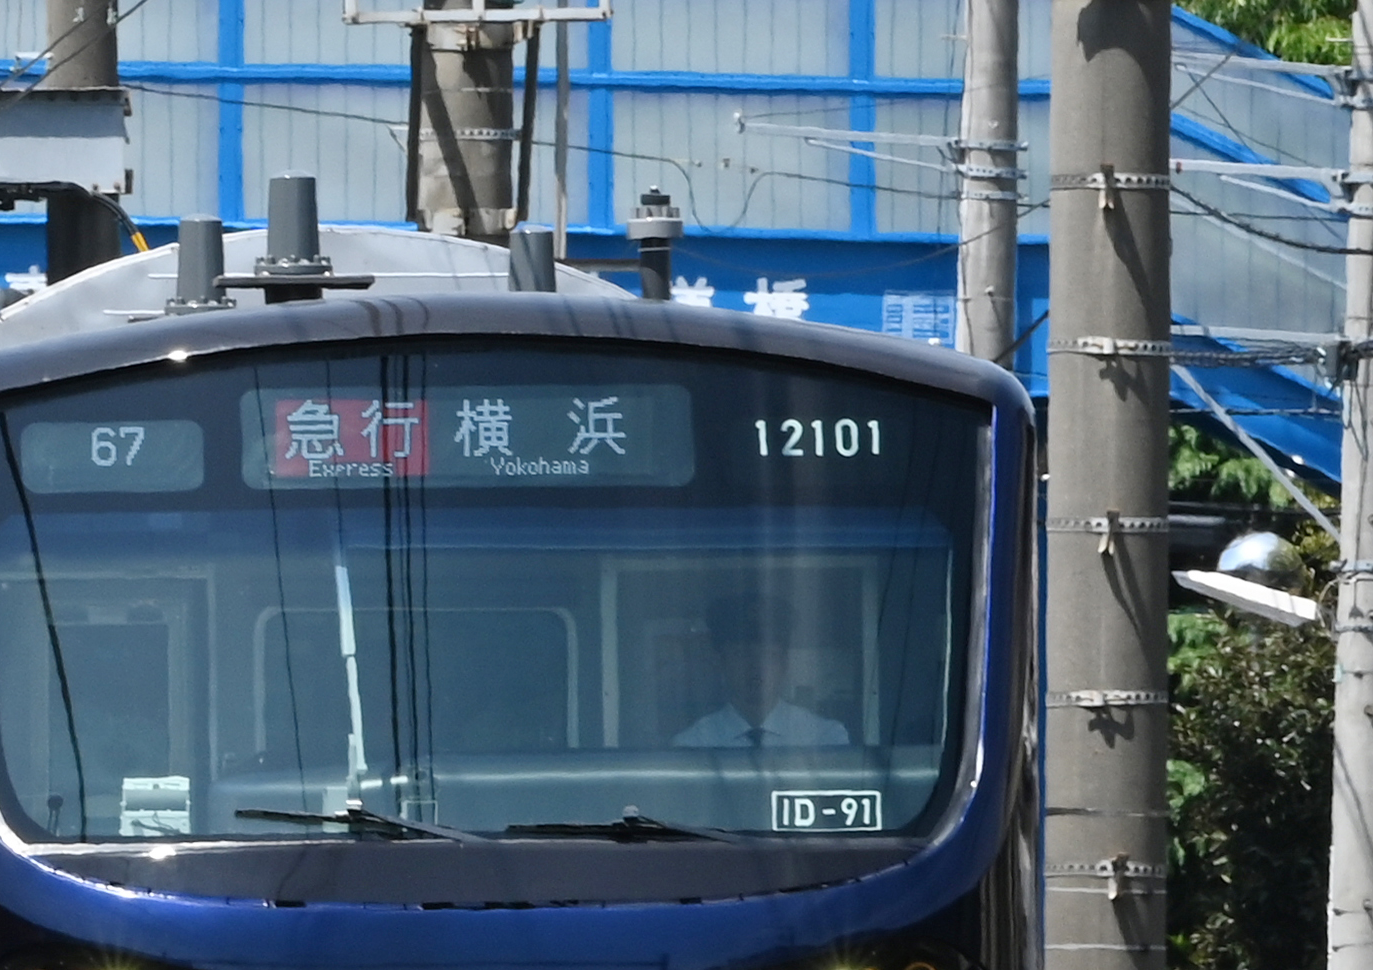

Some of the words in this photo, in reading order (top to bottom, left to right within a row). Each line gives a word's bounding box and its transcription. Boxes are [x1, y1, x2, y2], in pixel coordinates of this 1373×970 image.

[91, 426, 145, 467] 67
[285, 399, 419, 460] 急行
[454, 396, 627, 457] 横浜
[754, 417, 881, 458] 12101
[309, 459, 394, 478] Express
[489, 456, 590, 476] Yokohama
[782, 797, 871, 827] ID-91
